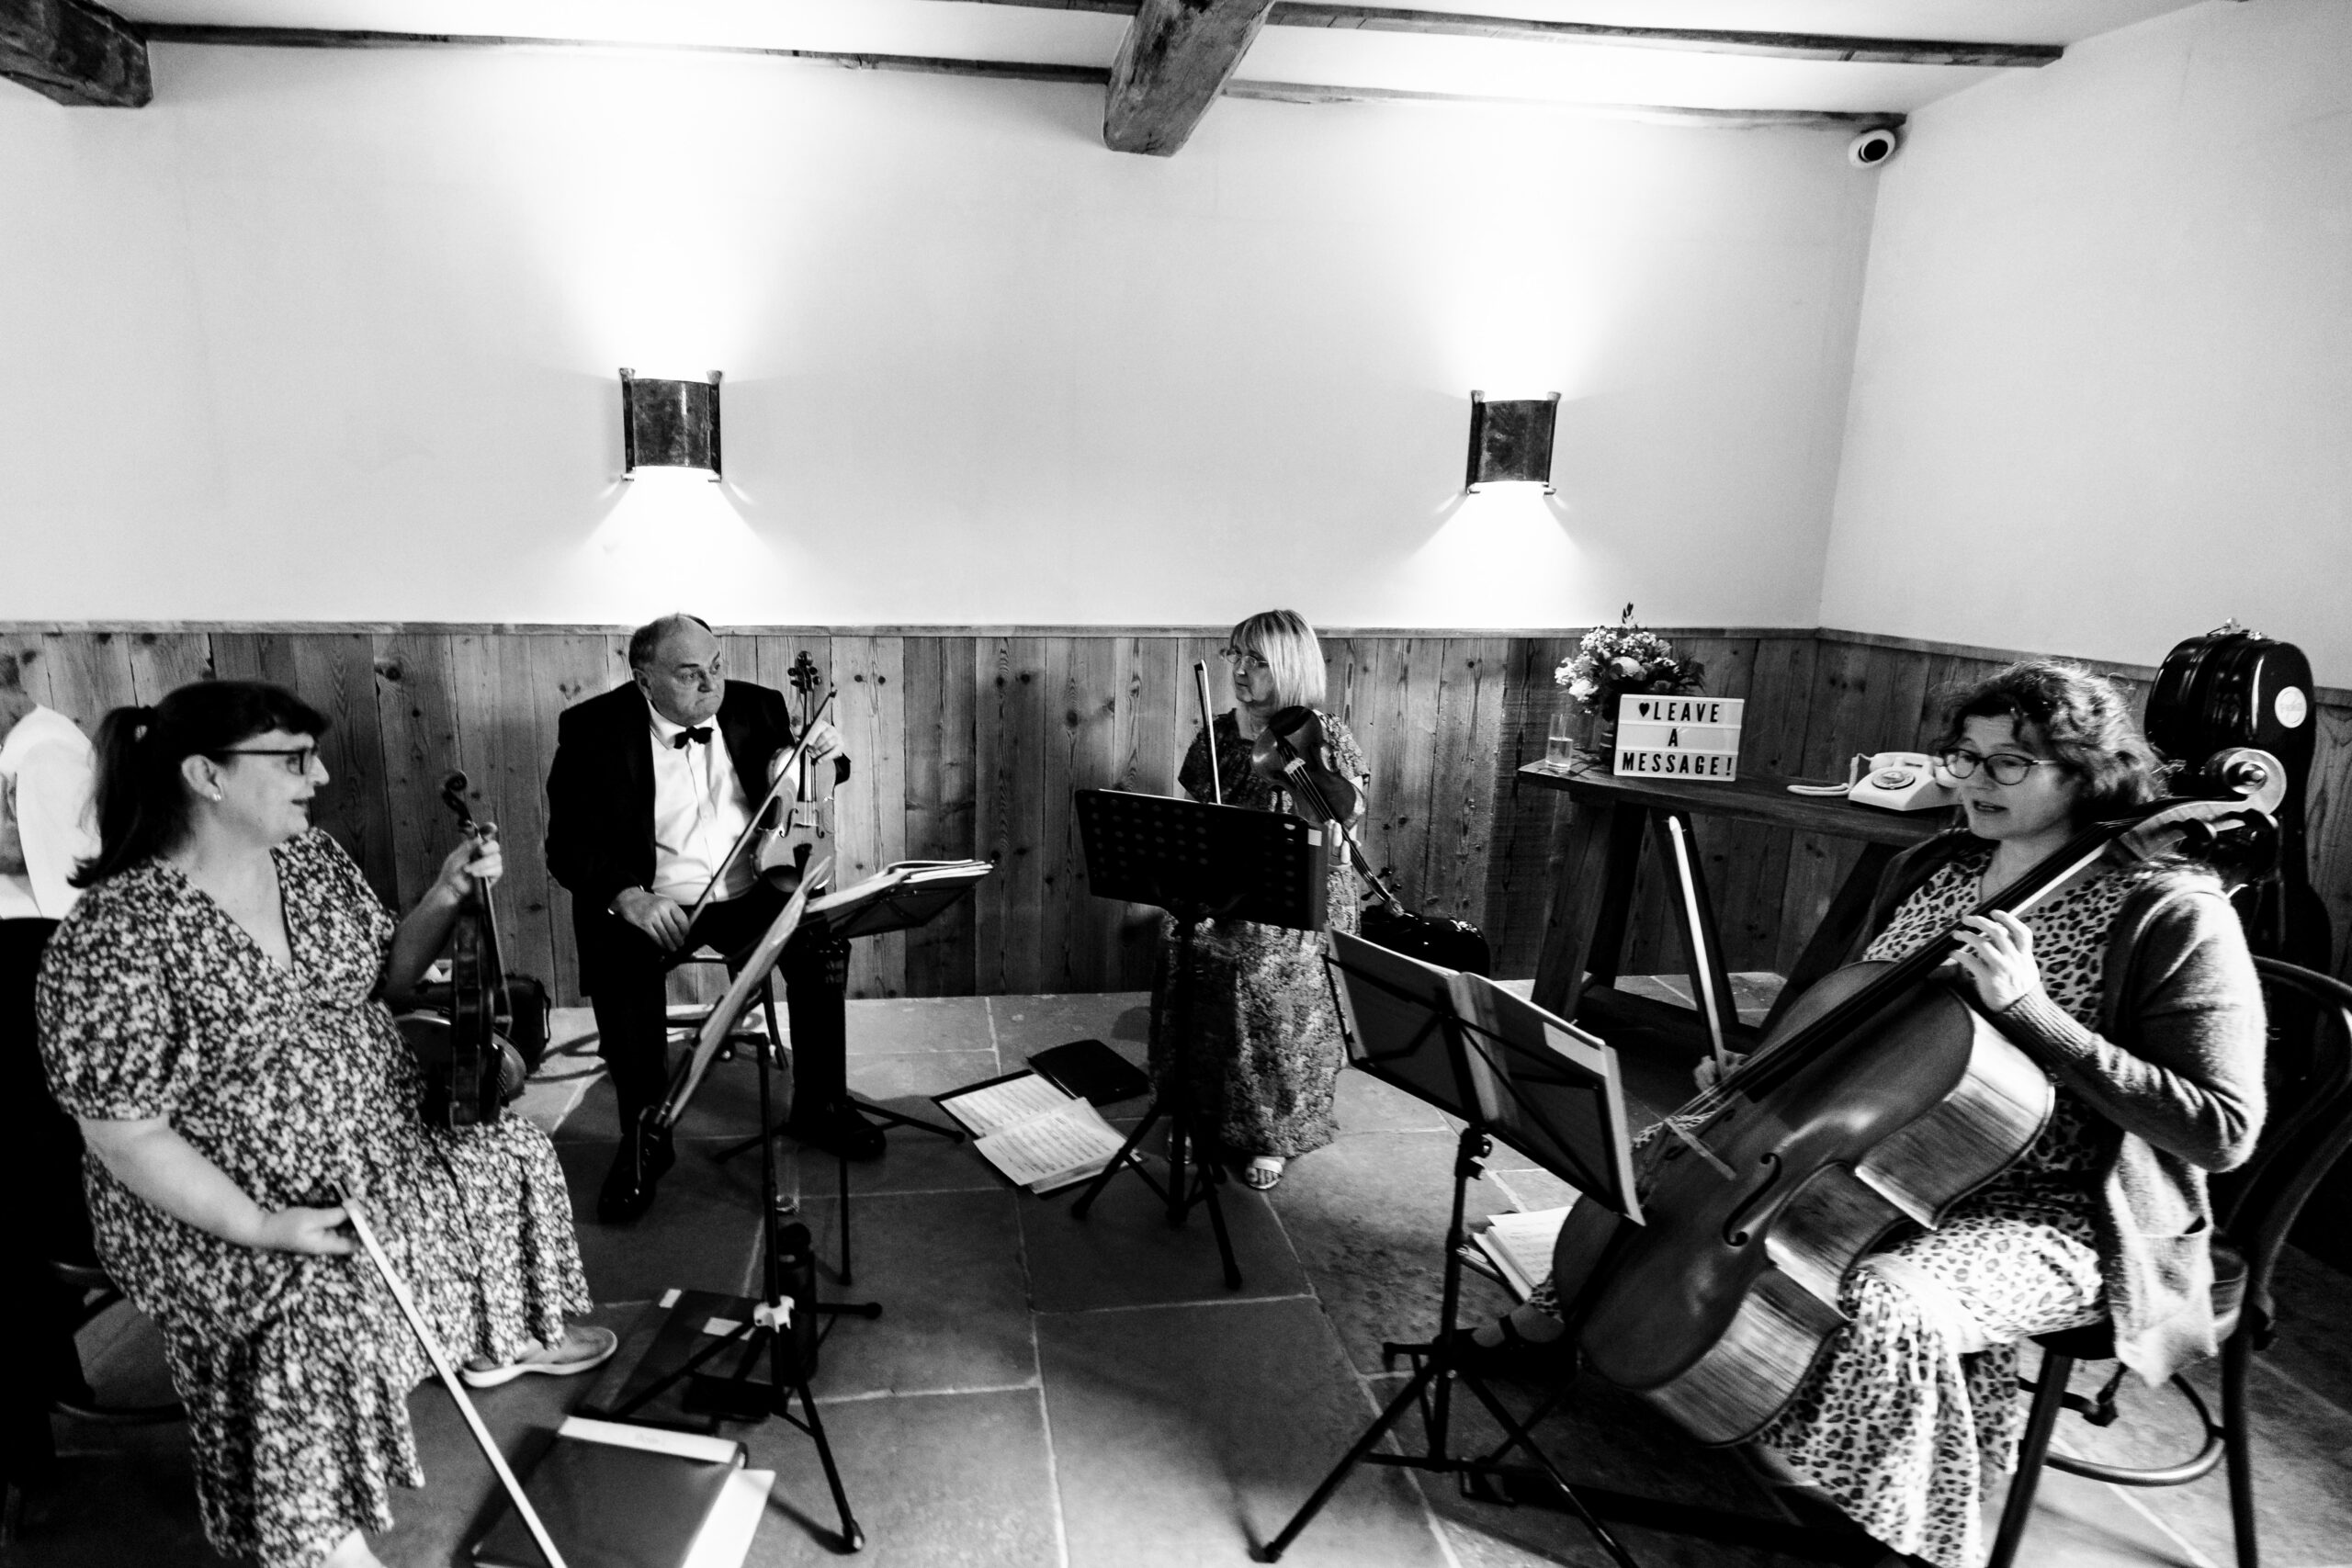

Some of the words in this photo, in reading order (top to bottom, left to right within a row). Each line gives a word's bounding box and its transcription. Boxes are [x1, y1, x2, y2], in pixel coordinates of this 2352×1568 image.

[1654, 702, 1720, 723] LEAVE
[1668, 728, 1679, 747] A
[1623, 752, 1732, 776] MESSAGE!
